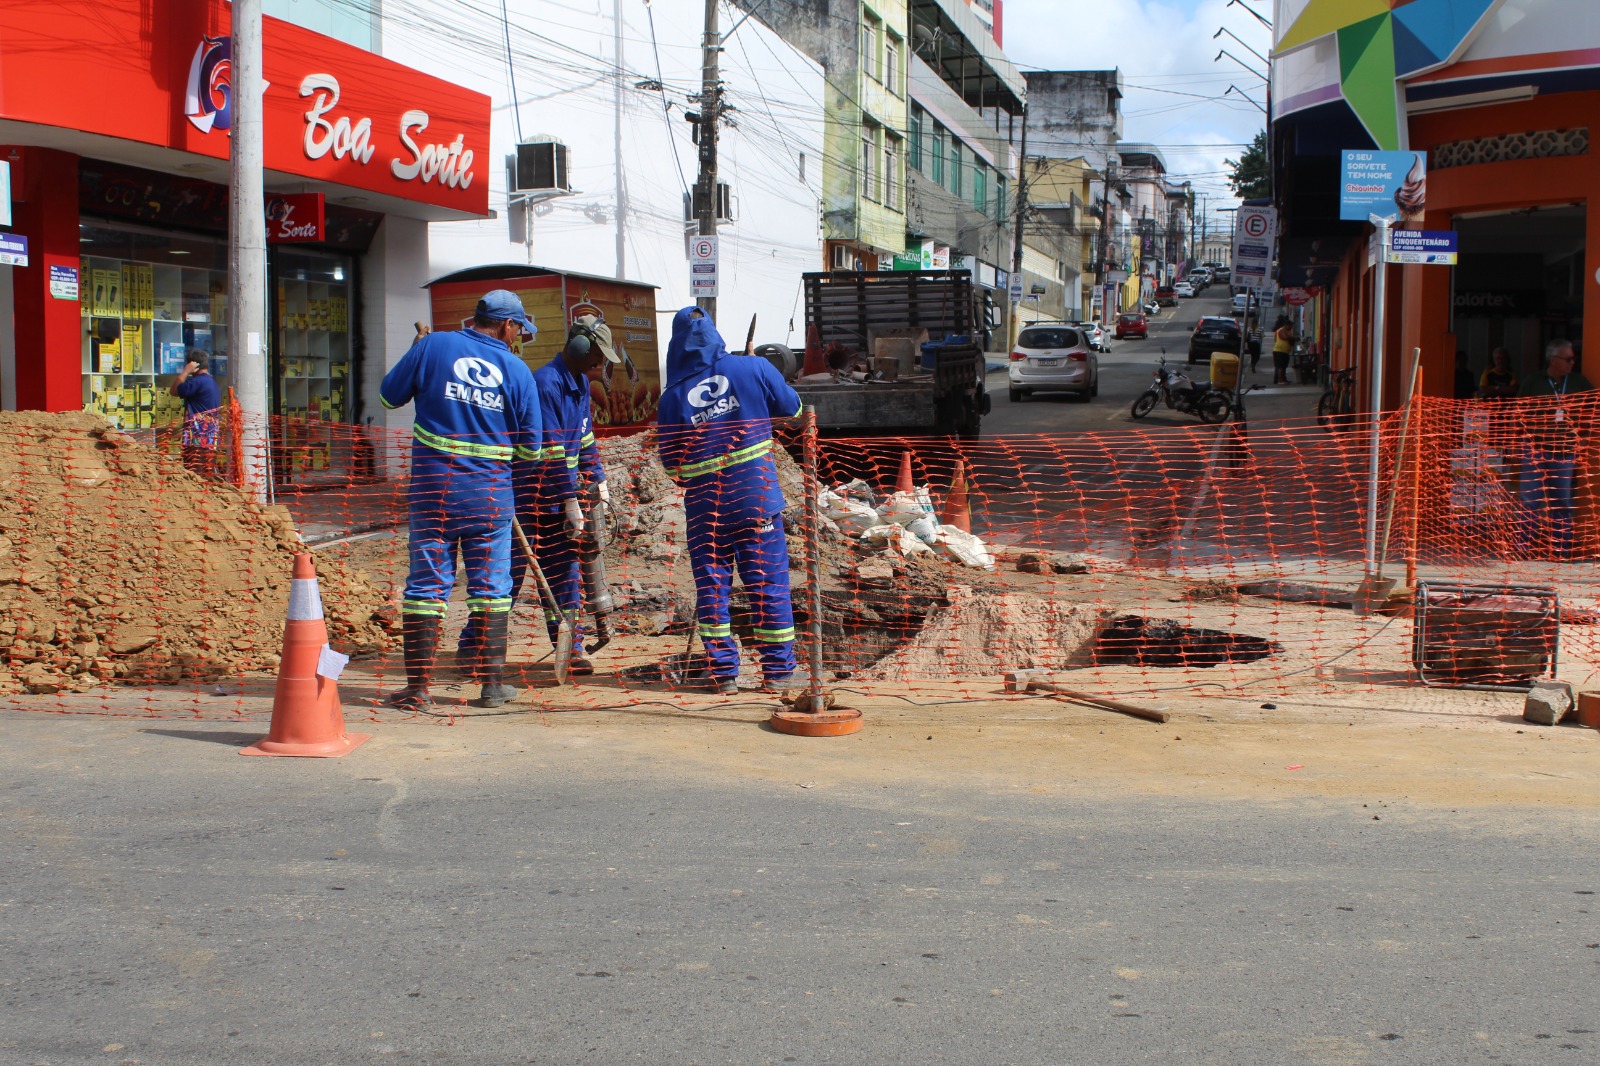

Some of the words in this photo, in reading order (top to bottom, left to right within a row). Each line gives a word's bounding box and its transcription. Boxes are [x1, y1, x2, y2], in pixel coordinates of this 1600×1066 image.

[299, 73, 376, 164] Boa
[391, 109, 474, 190] Sorte
[1345, 183, 1384, 193] Chiquinho
[278, 220, 316, 238] Sorte
[1251, 219, 1261, 232] E
[700, 244, 707, 254] E
[1394, 238, 1450, 246] CINQUENTENÁRIO
[444, 380, 505, 410] EMASA
[690, 395, 741, 429] EMASA
